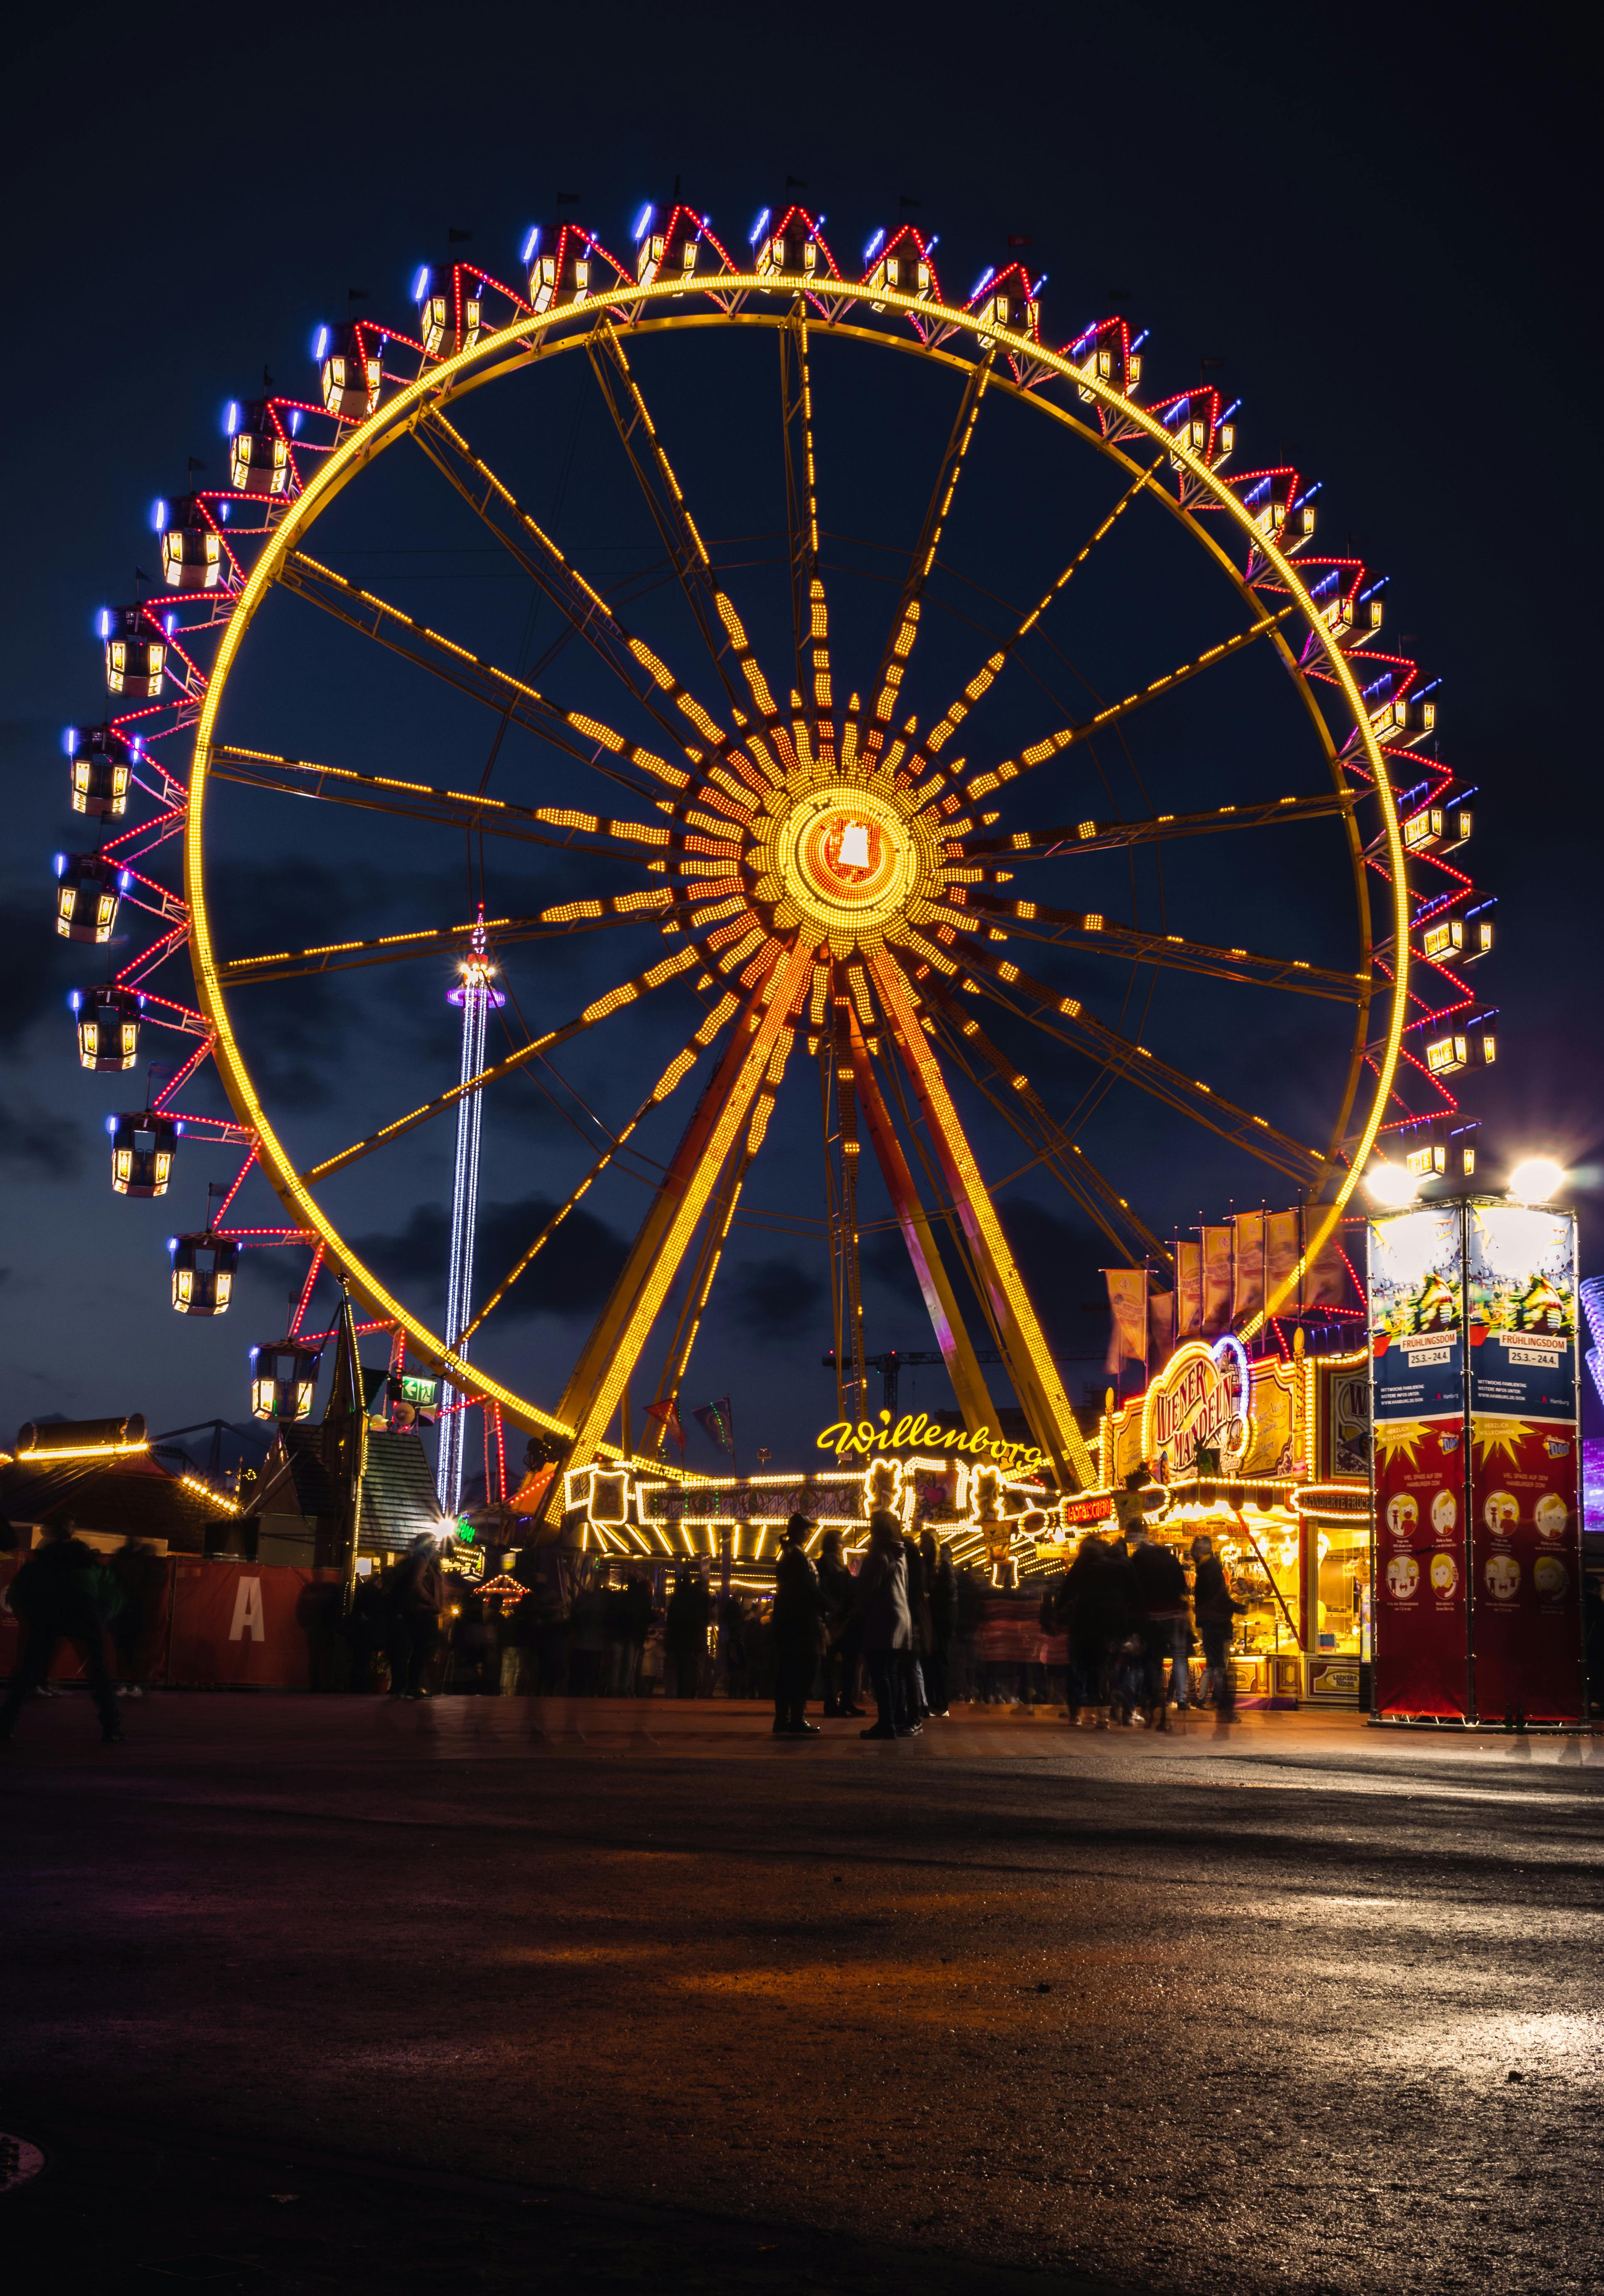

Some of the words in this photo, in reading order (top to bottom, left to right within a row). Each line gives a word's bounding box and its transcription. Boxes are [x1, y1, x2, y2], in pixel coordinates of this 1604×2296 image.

[1402, 1334, 1455, 1348] FRÜHLINGSDOM
[1502, 1334, 1564, 1349] FRÜHLINGSDOM
[1433, 1351, 1448, 1361] 24.4.
[1538, 1355, 1556, 1365] 24.4.
[1157, 1358, 1207, 1444] WIENER
[1173, 1373, 1232, 1469] MANDELN
[816, 1410, 1041, 1472] Willenborg
[1382, 1432, 1414, 1442] WILLKOMMEN
[1303, 1494, 1345, 1508] KANDIERTE
[1186, 1525, 1211, 1533] Nüsse
[228, 1576, 265, 1641] A
